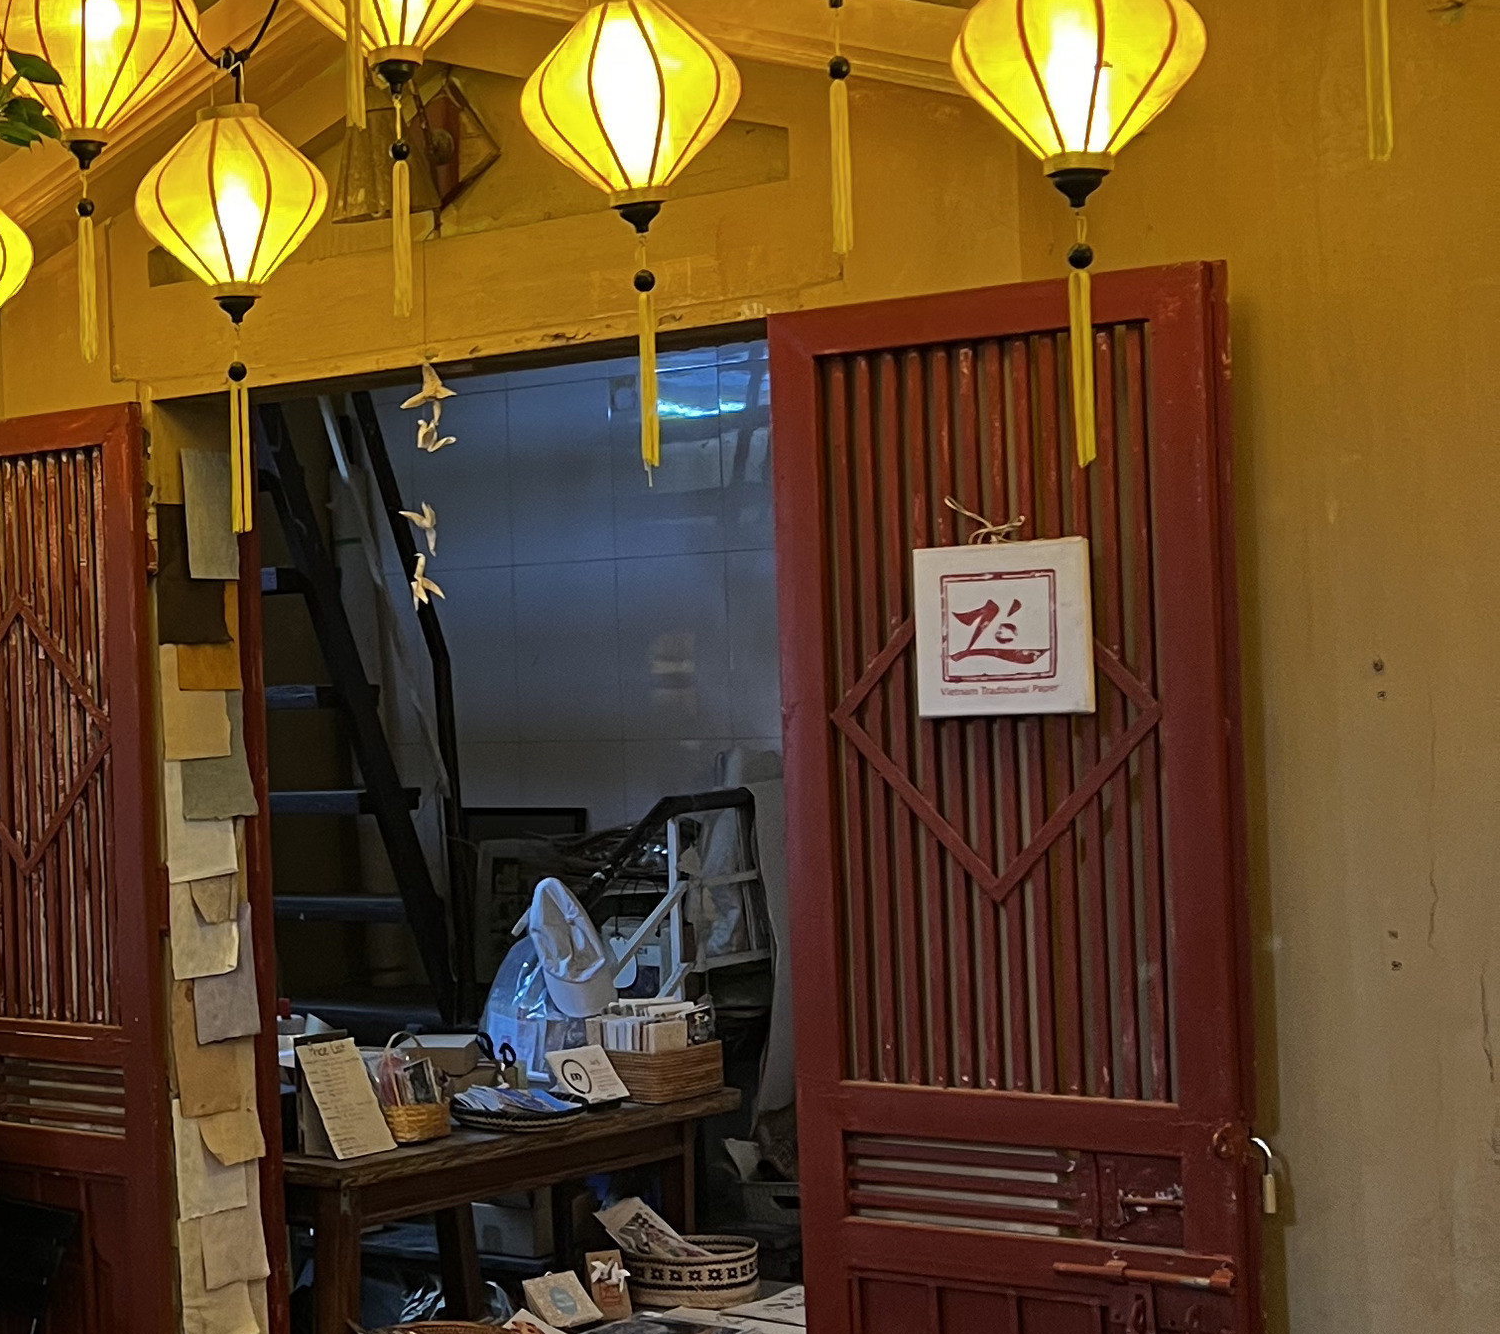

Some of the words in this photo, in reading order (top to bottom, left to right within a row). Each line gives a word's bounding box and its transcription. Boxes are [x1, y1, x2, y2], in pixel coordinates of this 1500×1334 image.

[940, 687, 979, 697] Vietnam
[981, 685, 1030, 696] Traditional
[1032, 683, 1059, 694] Paper
